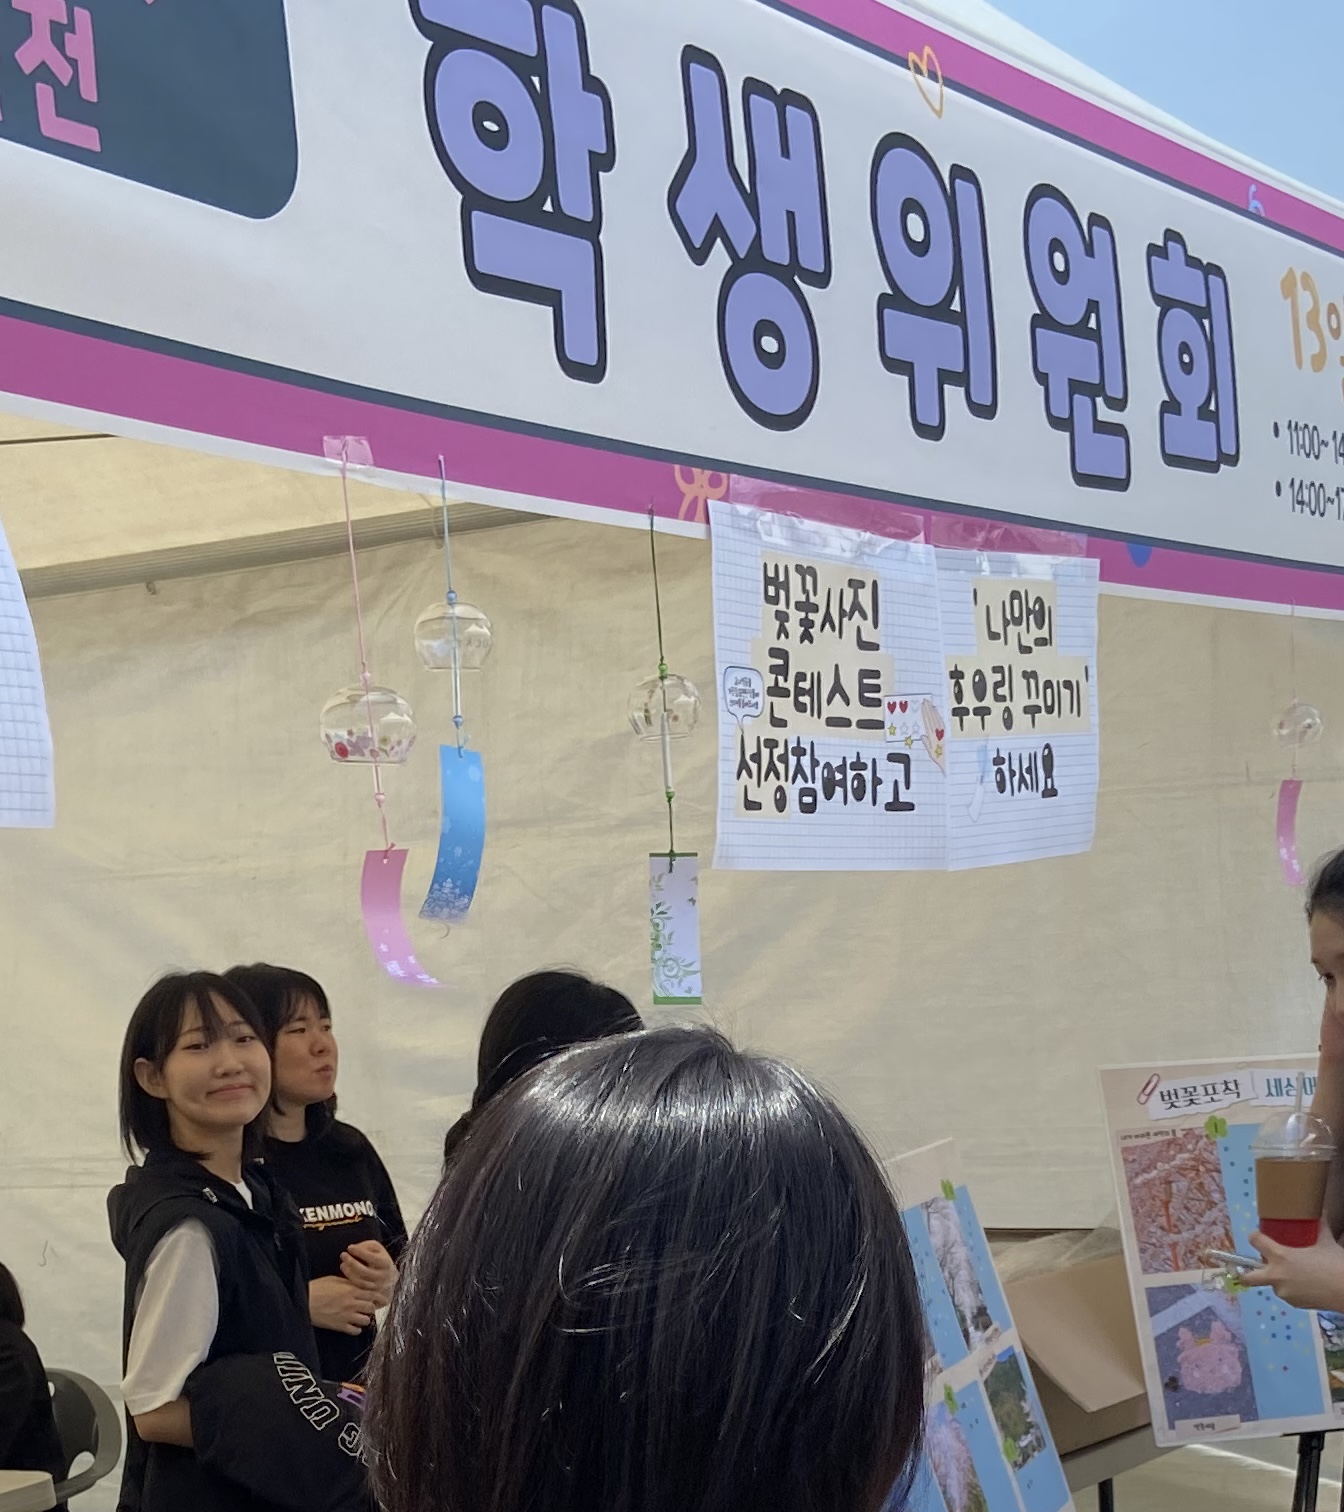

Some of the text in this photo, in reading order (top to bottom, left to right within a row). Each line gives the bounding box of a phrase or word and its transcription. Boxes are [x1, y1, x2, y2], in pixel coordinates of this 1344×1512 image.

[767, 646, 885, 730] 콘테스트
[992, 743, 1058, 799] 하세요
[1160, 1080, 1241, 1110] 벚꽃포착
